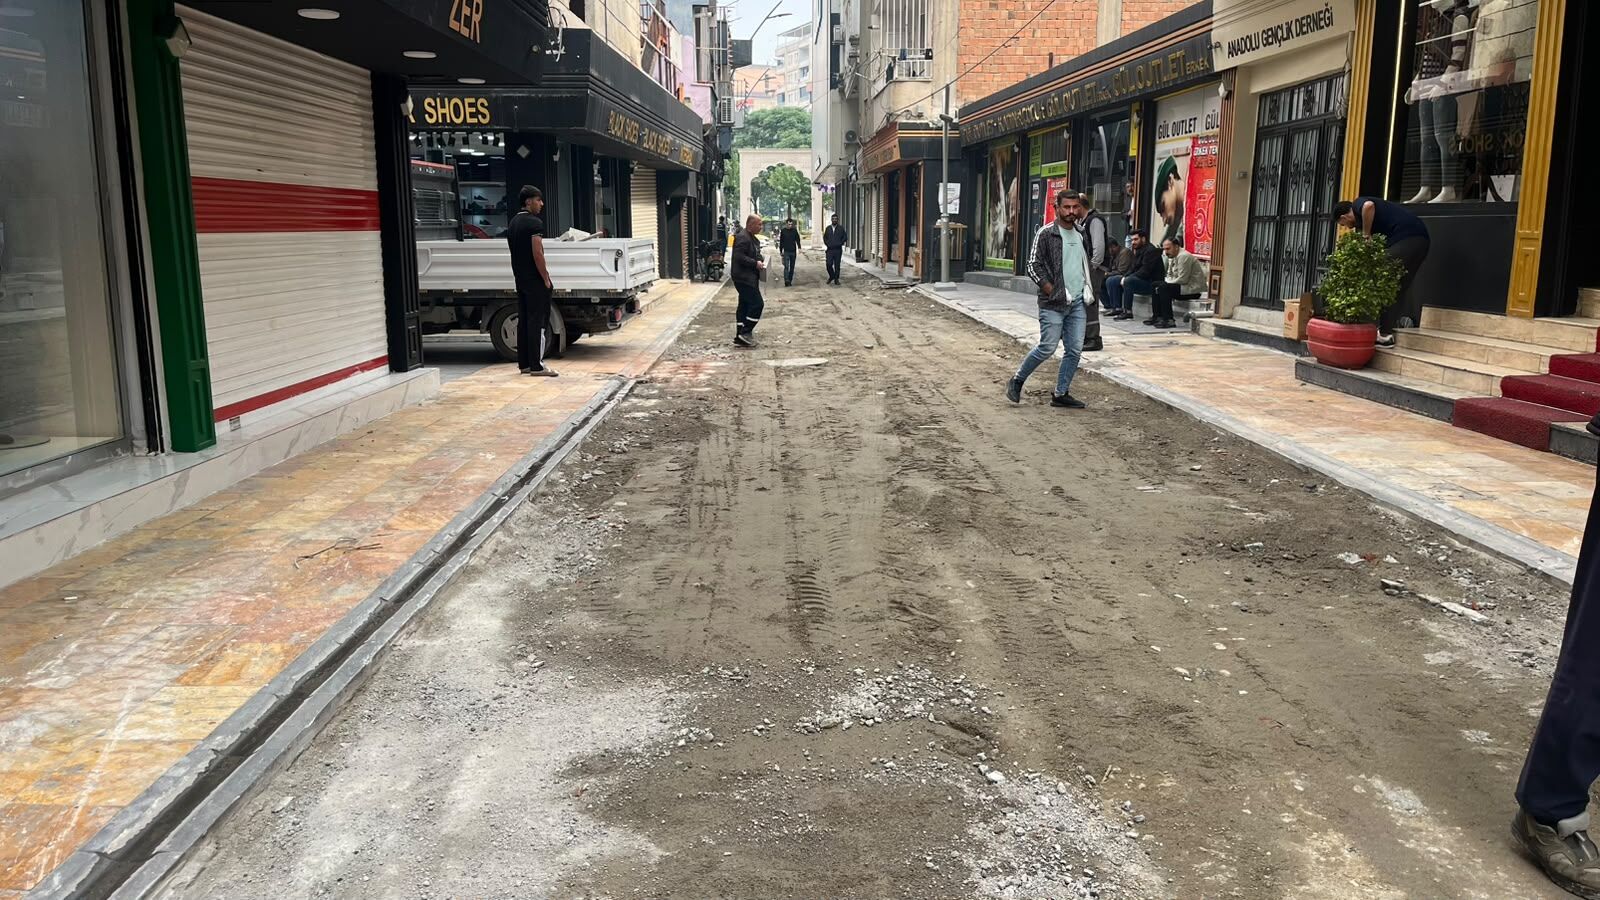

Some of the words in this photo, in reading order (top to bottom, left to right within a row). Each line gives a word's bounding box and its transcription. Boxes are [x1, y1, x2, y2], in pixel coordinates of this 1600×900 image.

[1227, 31, 1259, 58] ANADOLU
[1136, 49, 1185, 90] OUTLET
[424, 97, 490, 124] SHOES
[1158, 123, 1170, 139] GÜL
[1171, 117, 1197, 138] OUTLET
[1205, 109, 1220, 131] GÜL
